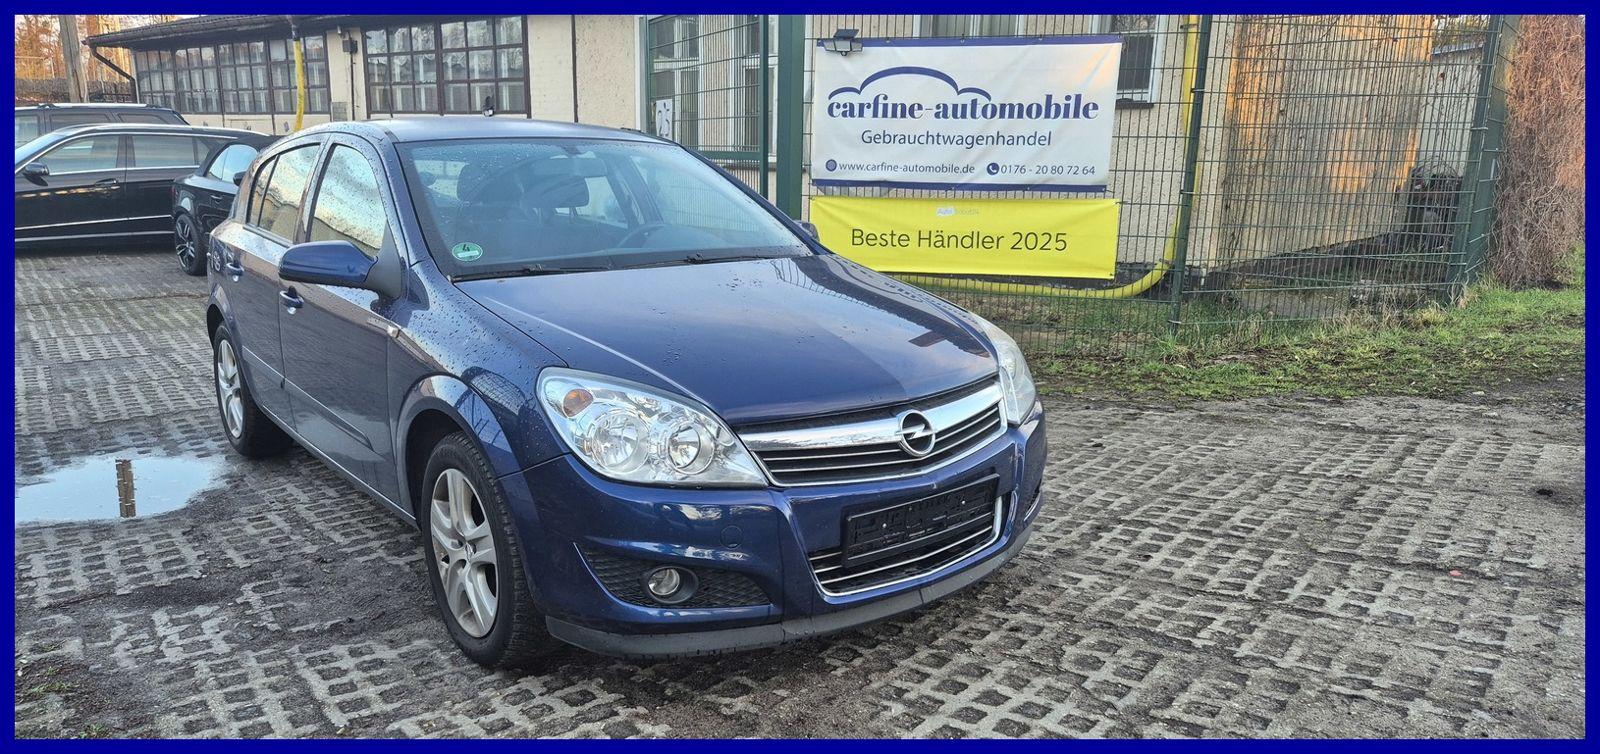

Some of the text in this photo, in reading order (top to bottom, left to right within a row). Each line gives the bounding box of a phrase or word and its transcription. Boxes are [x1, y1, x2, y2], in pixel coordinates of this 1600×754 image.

[827, 93, 1099, 120] carfine-automobile
[861, 129, 1052, 149] Gebrauchtwagenhandel
[838, 162, 975, 175] www.carfine-automobile.de
[1000, 164, 1026, 175] 0176
[1035, 165, 1048, 175] 20
[1051, 165, 1063, 175] 80
[1067, 165, 1079, 175] 72
[1082, 165, 1095, 175] 64
[851, 228, 1068, 251] Beste Händler 2025
